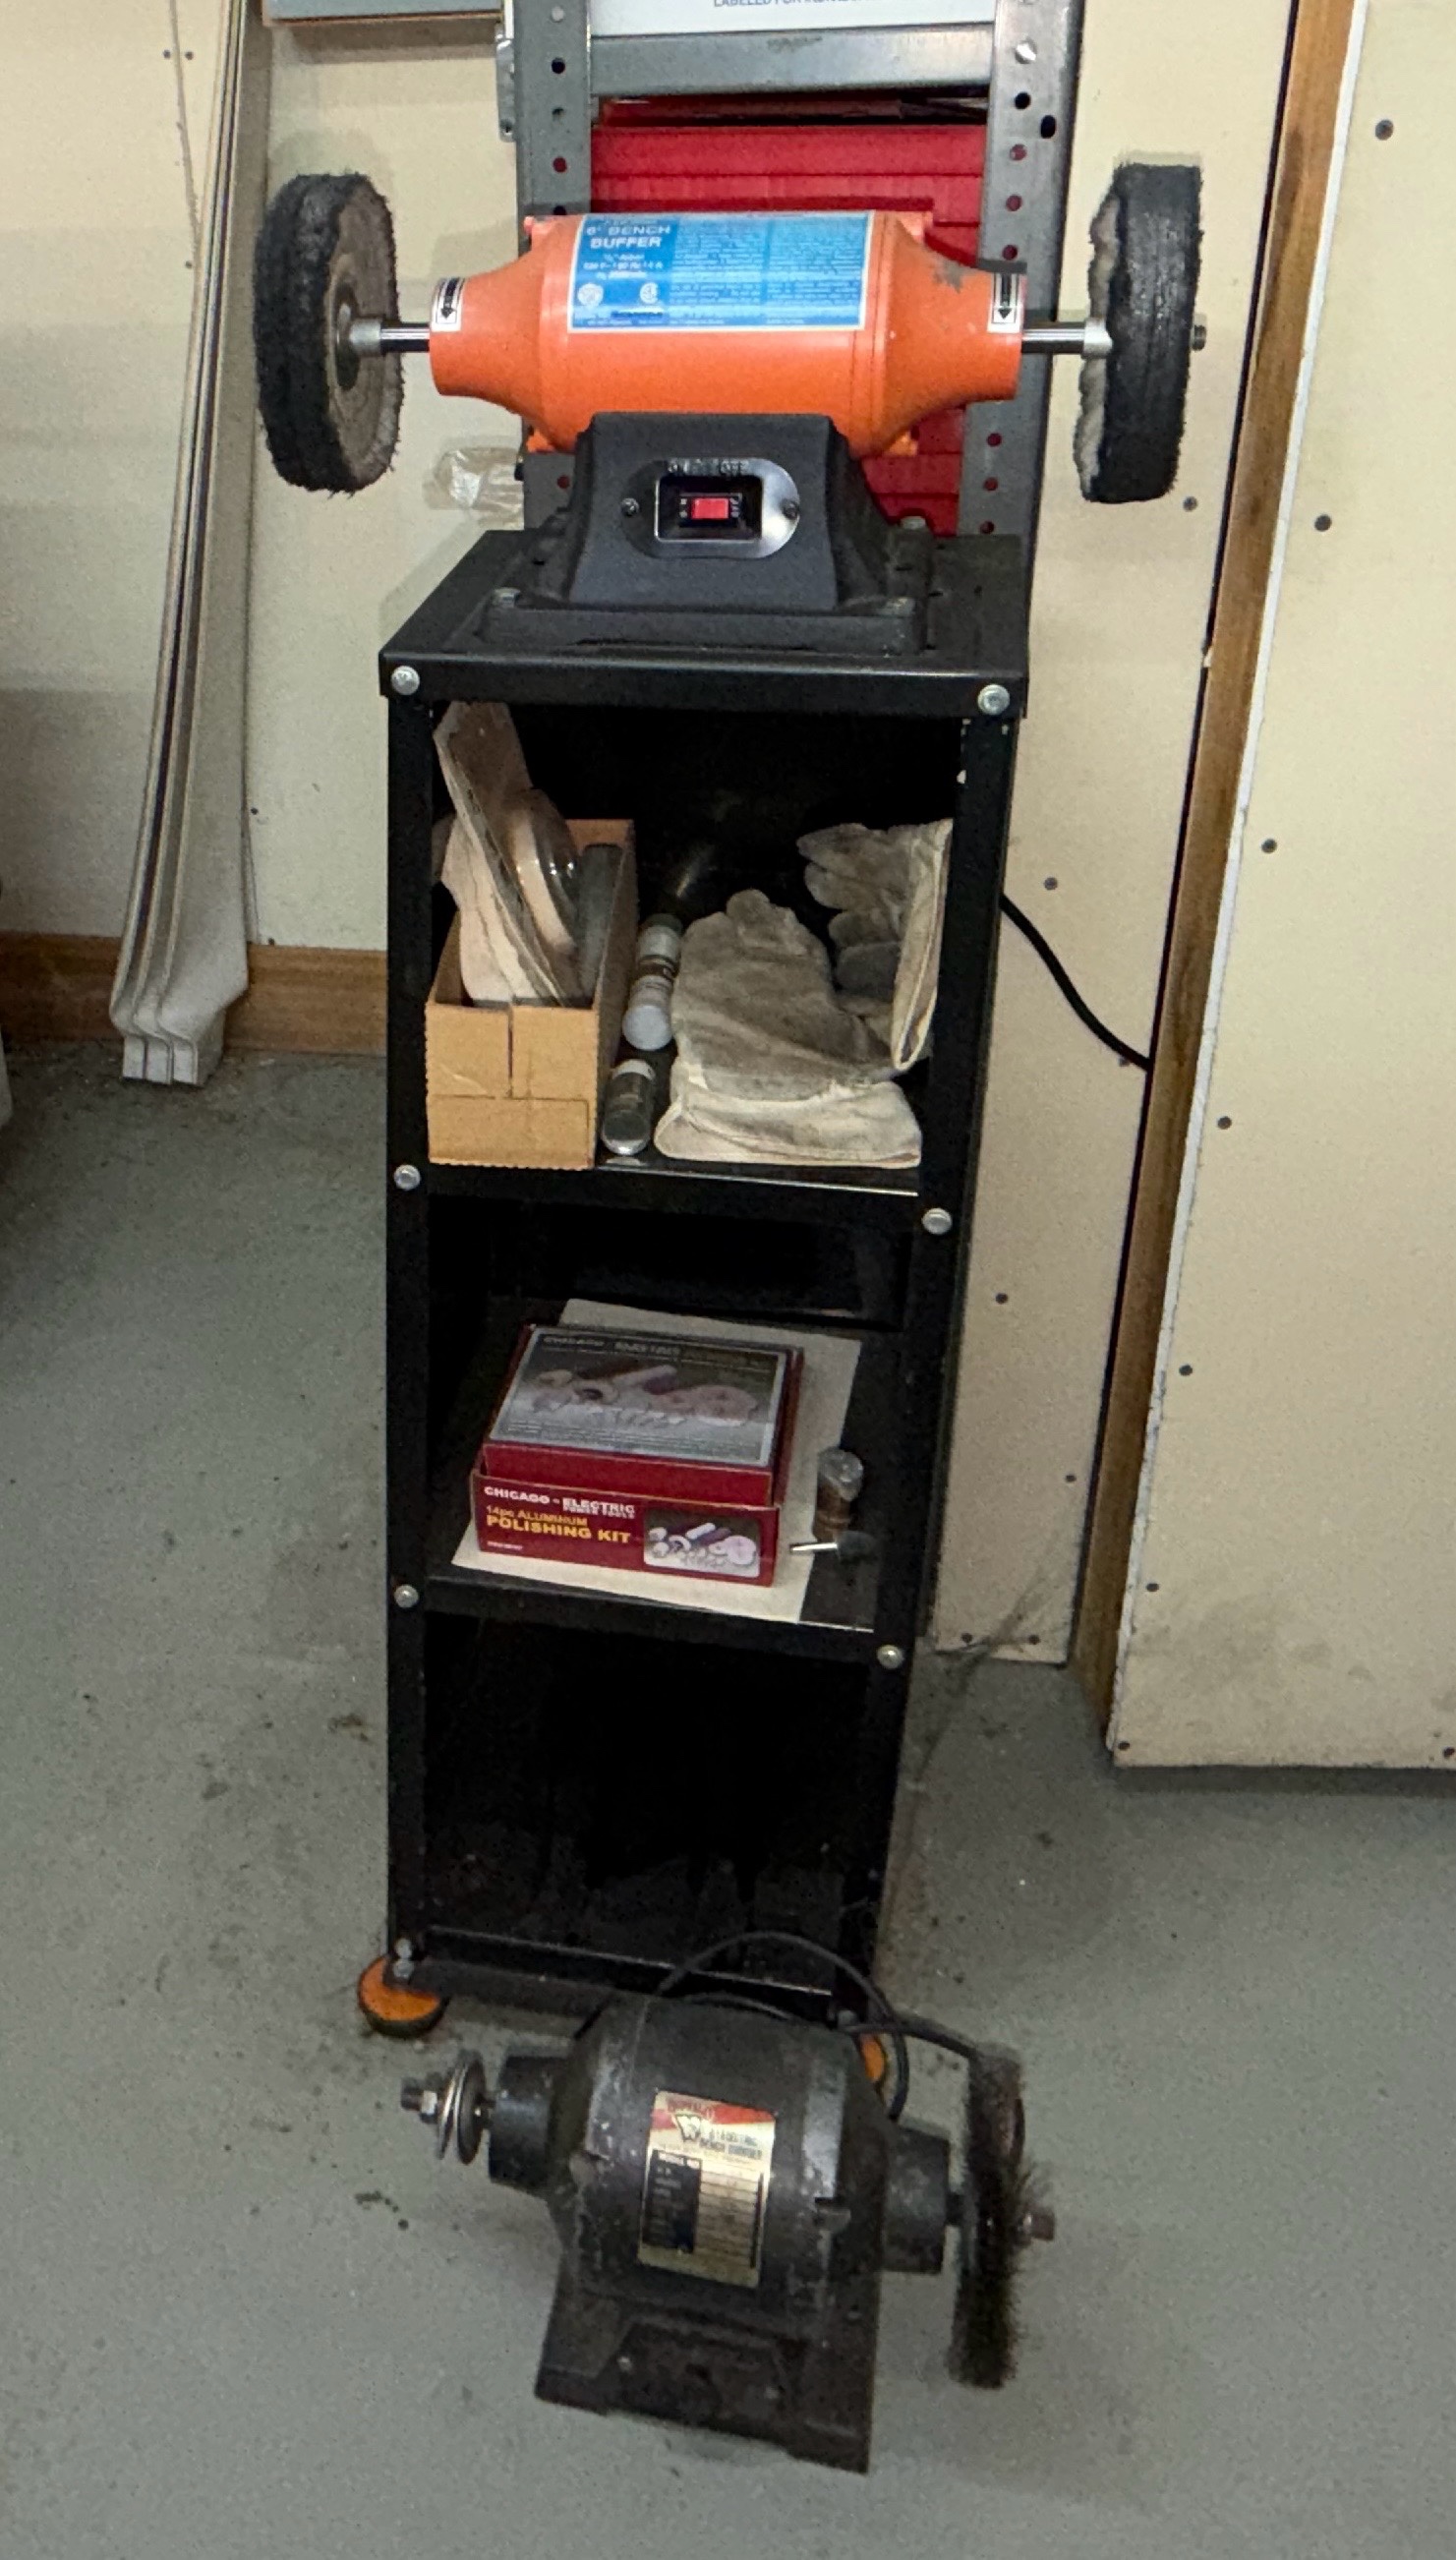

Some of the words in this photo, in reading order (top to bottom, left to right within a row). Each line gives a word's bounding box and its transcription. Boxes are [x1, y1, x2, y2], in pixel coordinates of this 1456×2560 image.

[608, 225, 670, 235] BENCH
[590, 236, 663, 249] BUFFER
[484, 1485, 551, 1505] CHICAGO
[562, 1496, 636, 1515] ELECTRIC
[486, 1514, 592, 1541] POLISHING
[598, 1529, 632, 1544] KIT
